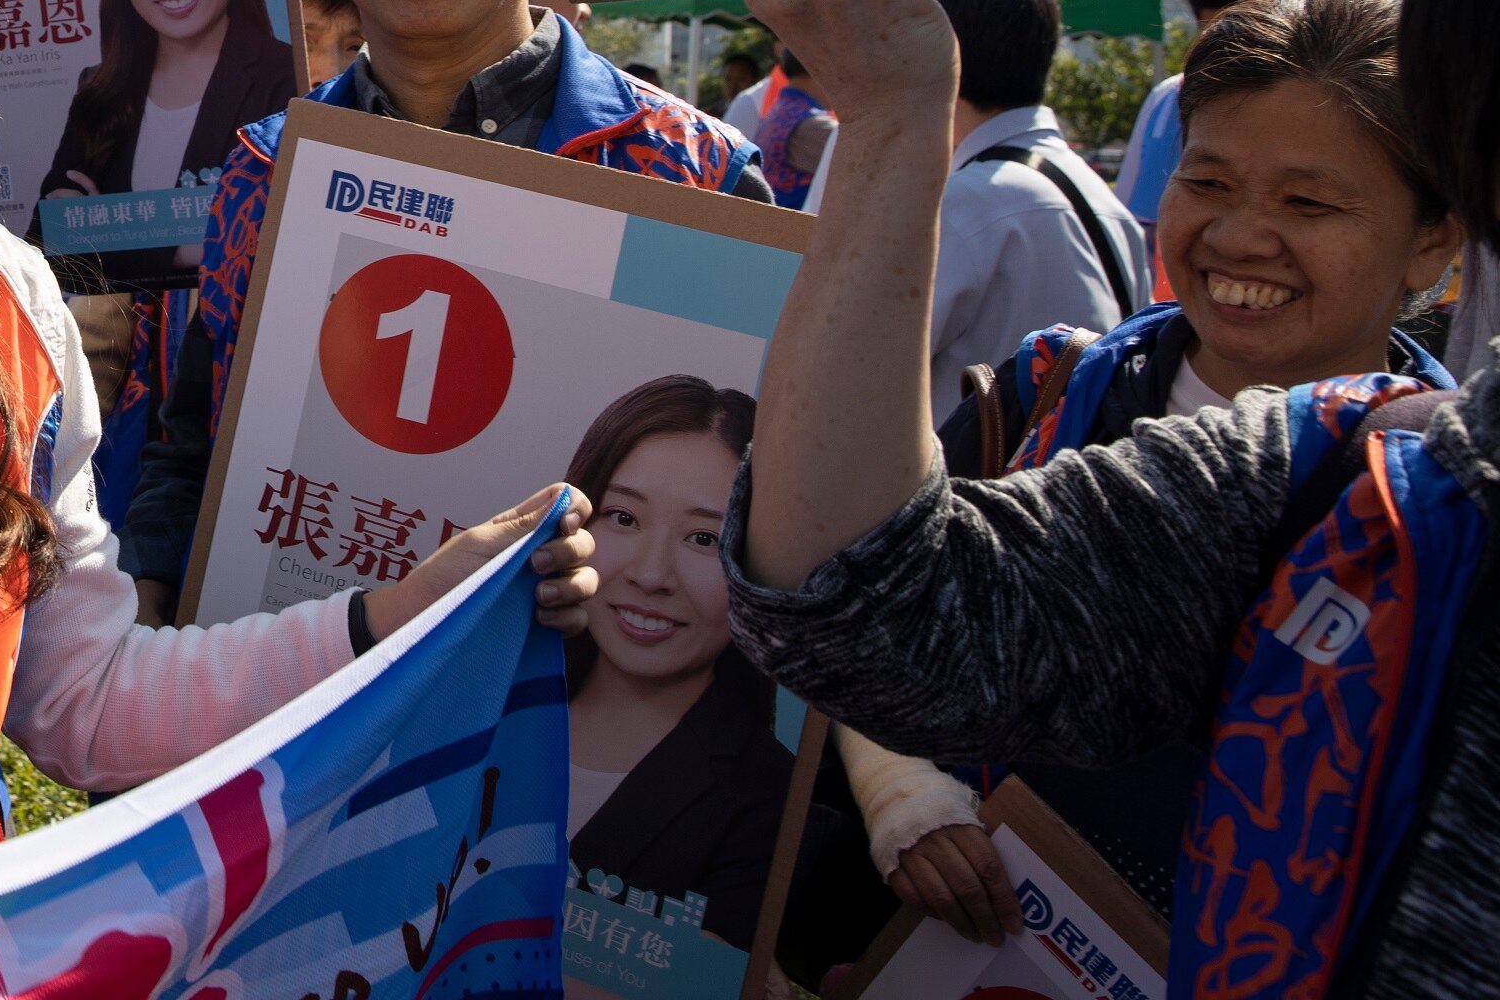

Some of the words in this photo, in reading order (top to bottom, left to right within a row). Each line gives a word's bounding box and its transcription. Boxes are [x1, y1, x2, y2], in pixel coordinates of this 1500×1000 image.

[16, 51, 38, 64] Yan
[41, 49, 61, 61] Iris
[63, 200, 157, 229] 情融東華
[368, 180, 455, 225] 民建聯
[404, 218, 450, 238] DAB
[376, 289, 455, 425] 1
[254, 466, 468, 582] 張嘉
[278, 556, 346, 592] Cheung
[617, 964, 646, 988] You
